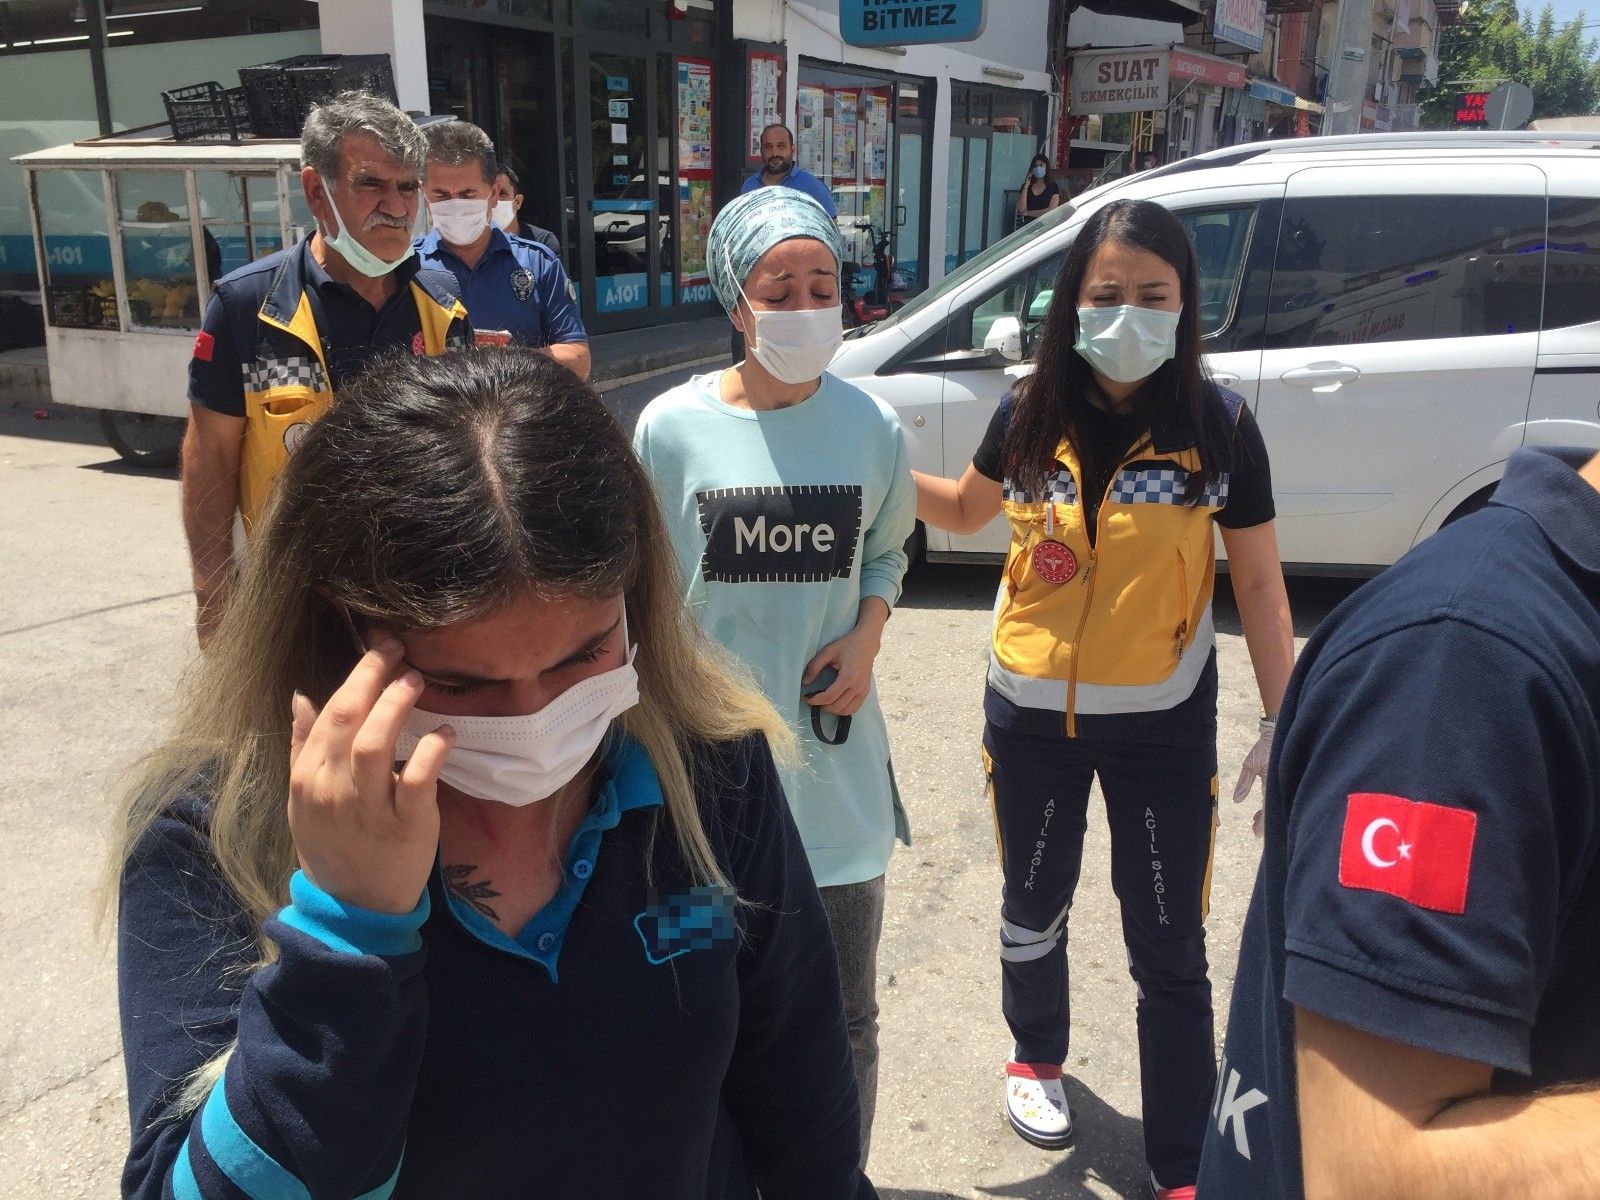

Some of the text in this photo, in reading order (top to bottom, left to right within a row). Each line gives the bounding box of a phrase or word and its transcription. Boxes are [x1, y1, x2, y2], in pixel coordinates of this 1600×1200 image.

[1097, 58, 1160, 84] SUAT
[1080, 84, 1159, 104] EKMEKÇİLİK
[733, 515, 835, 555] More
[1025, 841, 1046, 890] SAĞLIK
[1152, 861, 1170, 925] SAĞLIK
